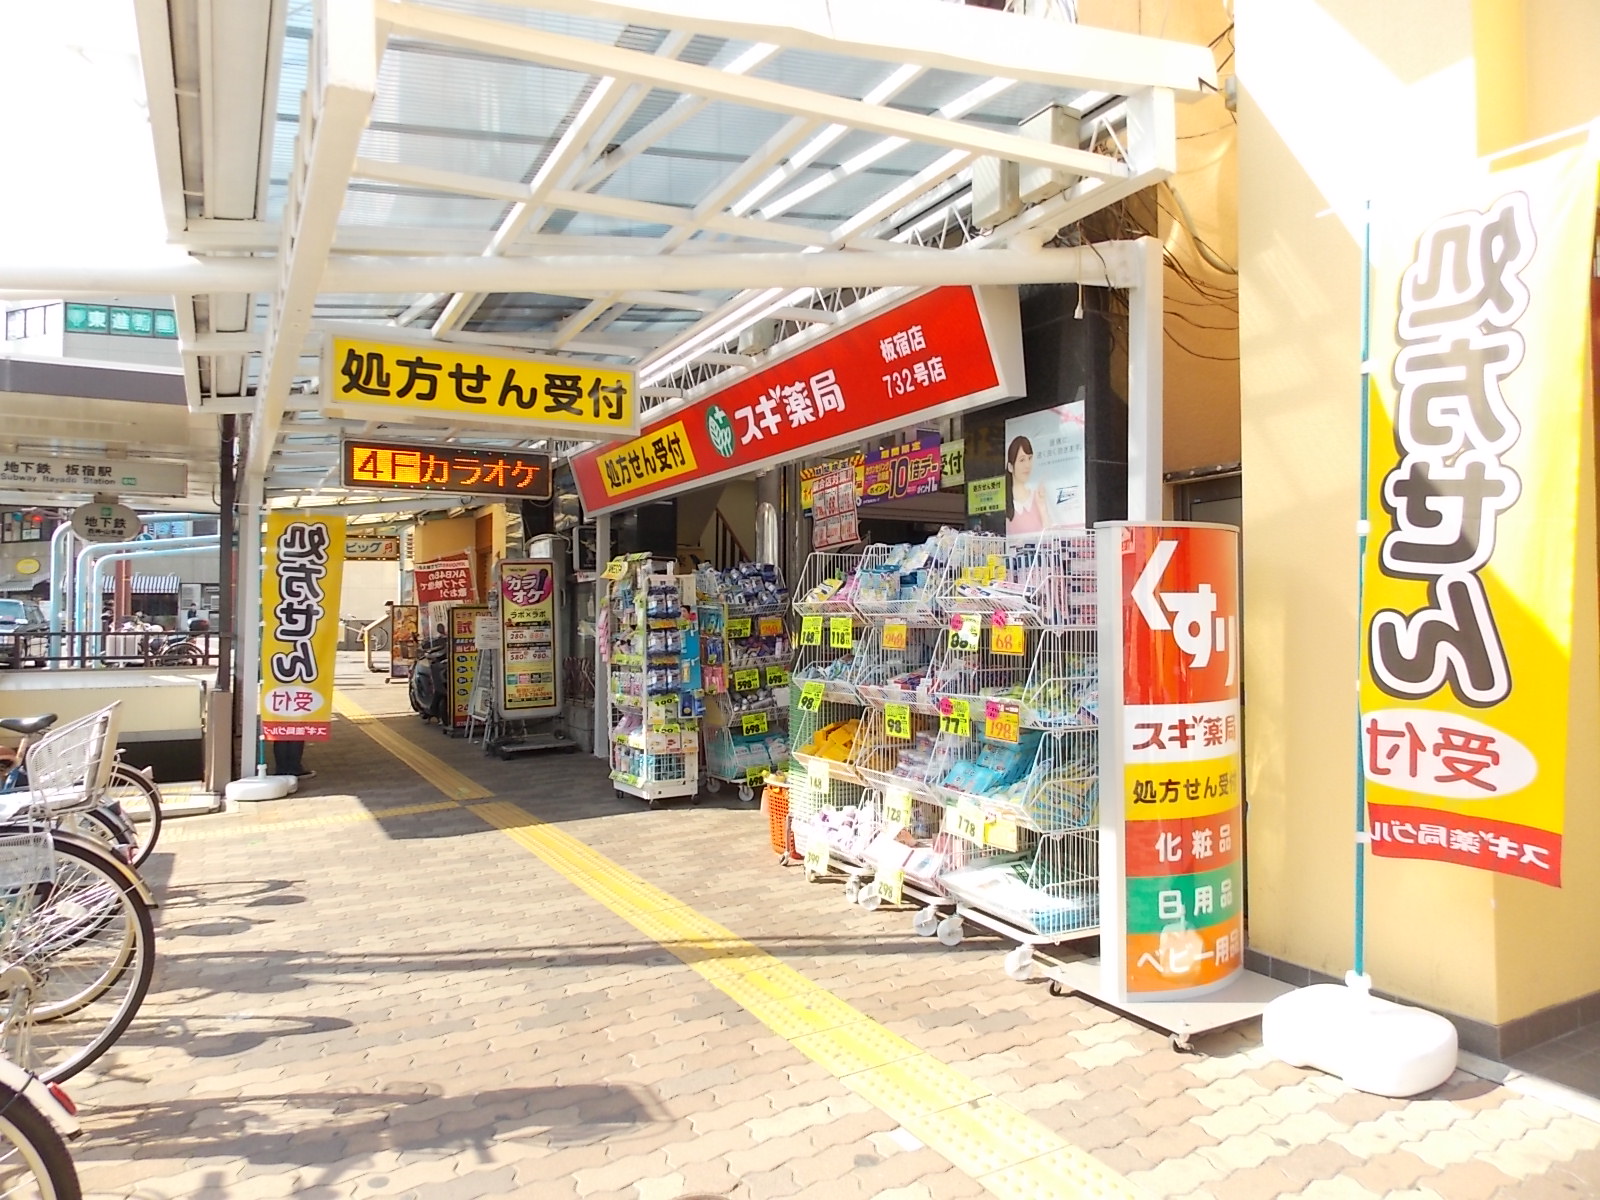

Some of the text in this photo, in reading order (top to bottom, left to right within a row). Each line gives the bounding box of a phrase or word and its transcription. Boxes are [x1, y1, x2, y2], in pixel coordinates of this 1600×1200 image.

[880, 325, 926, 364] 板宿店
[341, 348, 627, 420] 処方せん受付
[882, 356, 947, 400] 732号店
[735, 369, 846, 446] スギ薬局
[4, 461, 112, 477] 地下鉄 板宿駅
[603, 431, 685, 489] 処方せん受付
[1, 473, 37, 483] Subway
[83, 477, 116, 486] Station
[84, 517, 127, 529] 地下鉄
[1131, 540, 1235, 686] くすり
[832, 631, 845, 644] 118
[996, 634, 1013, 649] 68
[801, 695, 815, 709] 98
[942, 716, 960, 733] 77
[990, 721, 1011, 738] 198
[1132, 715, 1236, 750] スギ薬局
[886, 806, 901, 822] 128
[957, 815, 976, 837] 178
[1155, 824, 1231, 863] 化粧品
[1158, 878, 1232, 919] 日用品
[1137, 928, 1240, 974] ベビー用品
